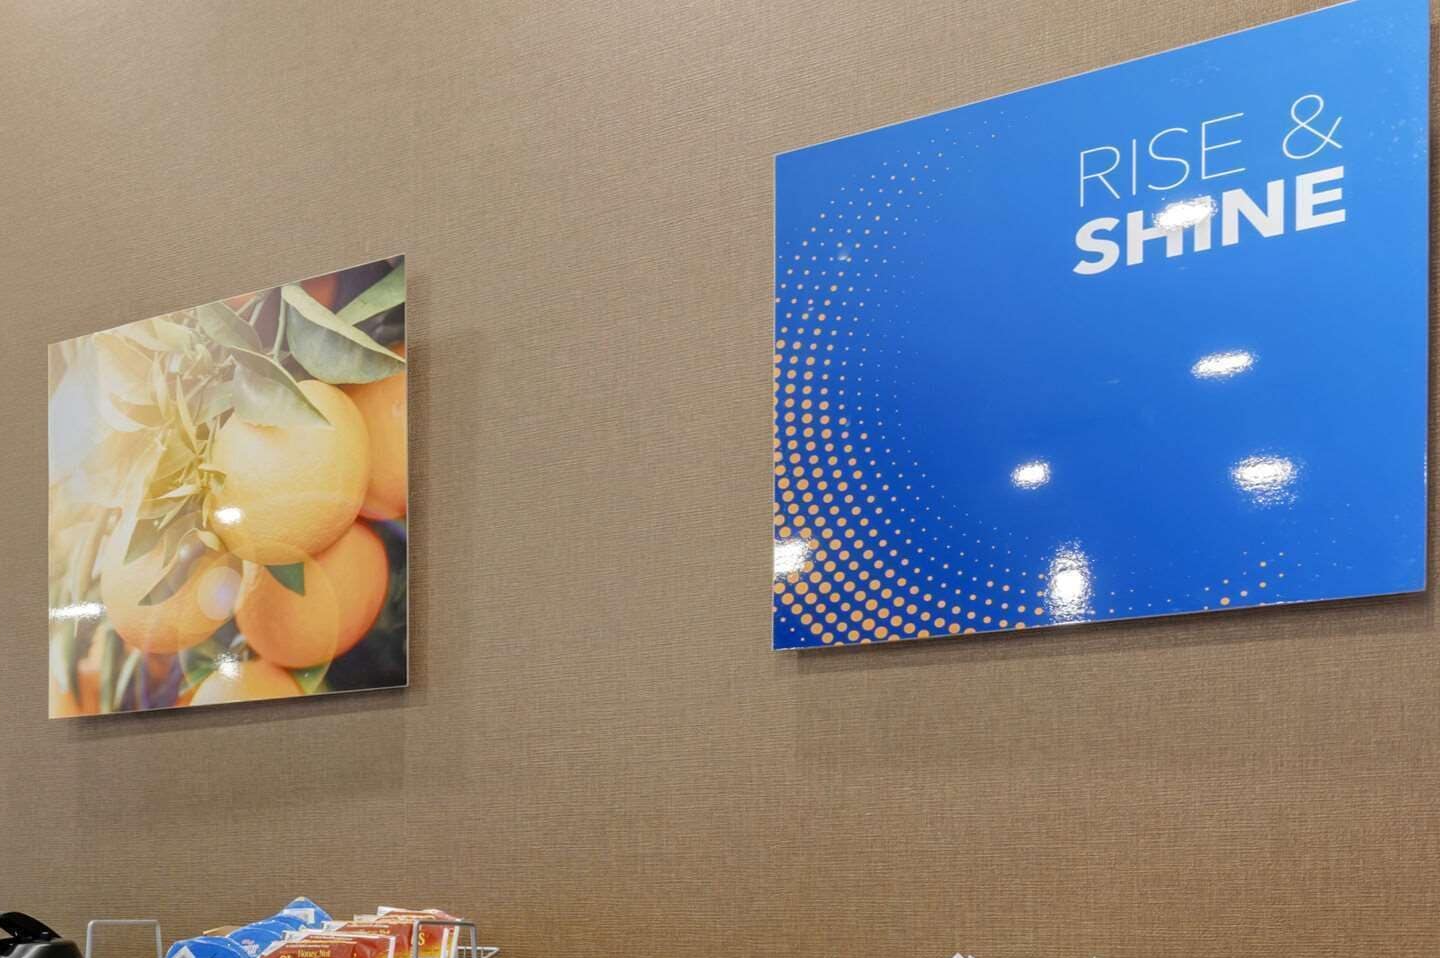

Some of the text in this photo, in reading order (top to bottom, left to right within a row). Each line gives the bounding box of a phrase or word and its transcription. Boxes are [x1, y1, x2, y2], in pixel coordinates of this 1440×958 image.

[1079, 93, 1344, 208] RISE &
[1071, 165, 1347, 275] SHINE
